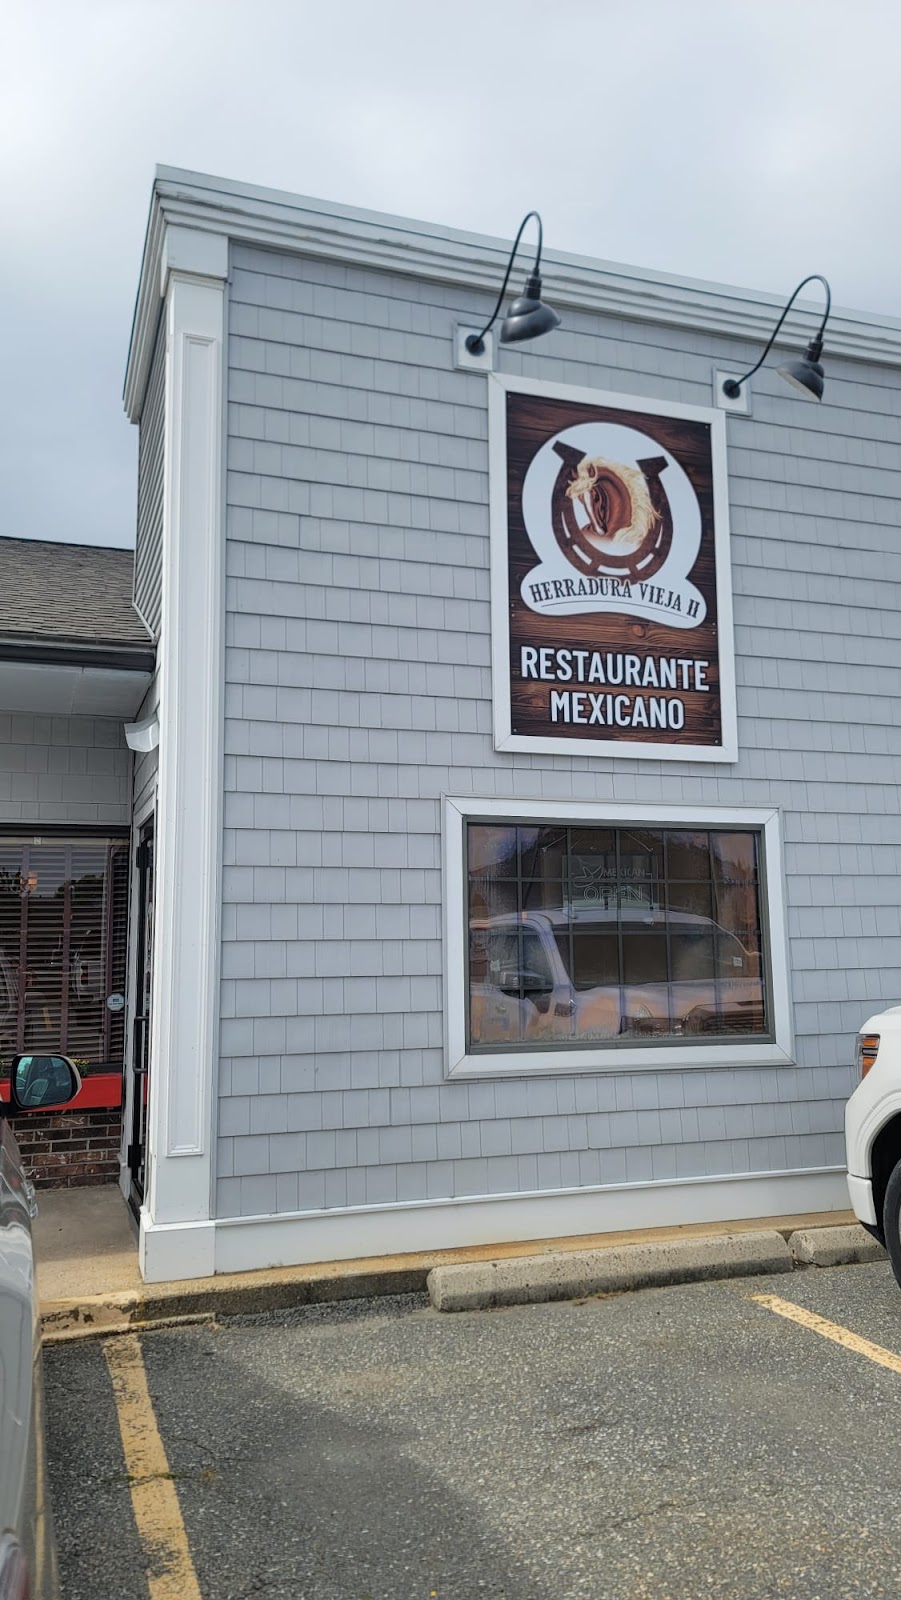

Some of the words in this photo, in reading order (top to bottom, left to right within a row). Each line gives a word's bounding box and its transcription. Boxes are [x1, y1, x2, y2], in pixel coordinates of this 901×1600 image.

[529, 578, 632, 603] HERRADURA
[639, 583, 682, 612] VIEJA
[687, 599, 700, 618] II
[521, 646, 710, 691] RESTAURANTE
[551, 690, 685, 730] MEXICANO
[603, 867, 646, 878] MEXICAN
[584, 885, 643, 903] OPEN
